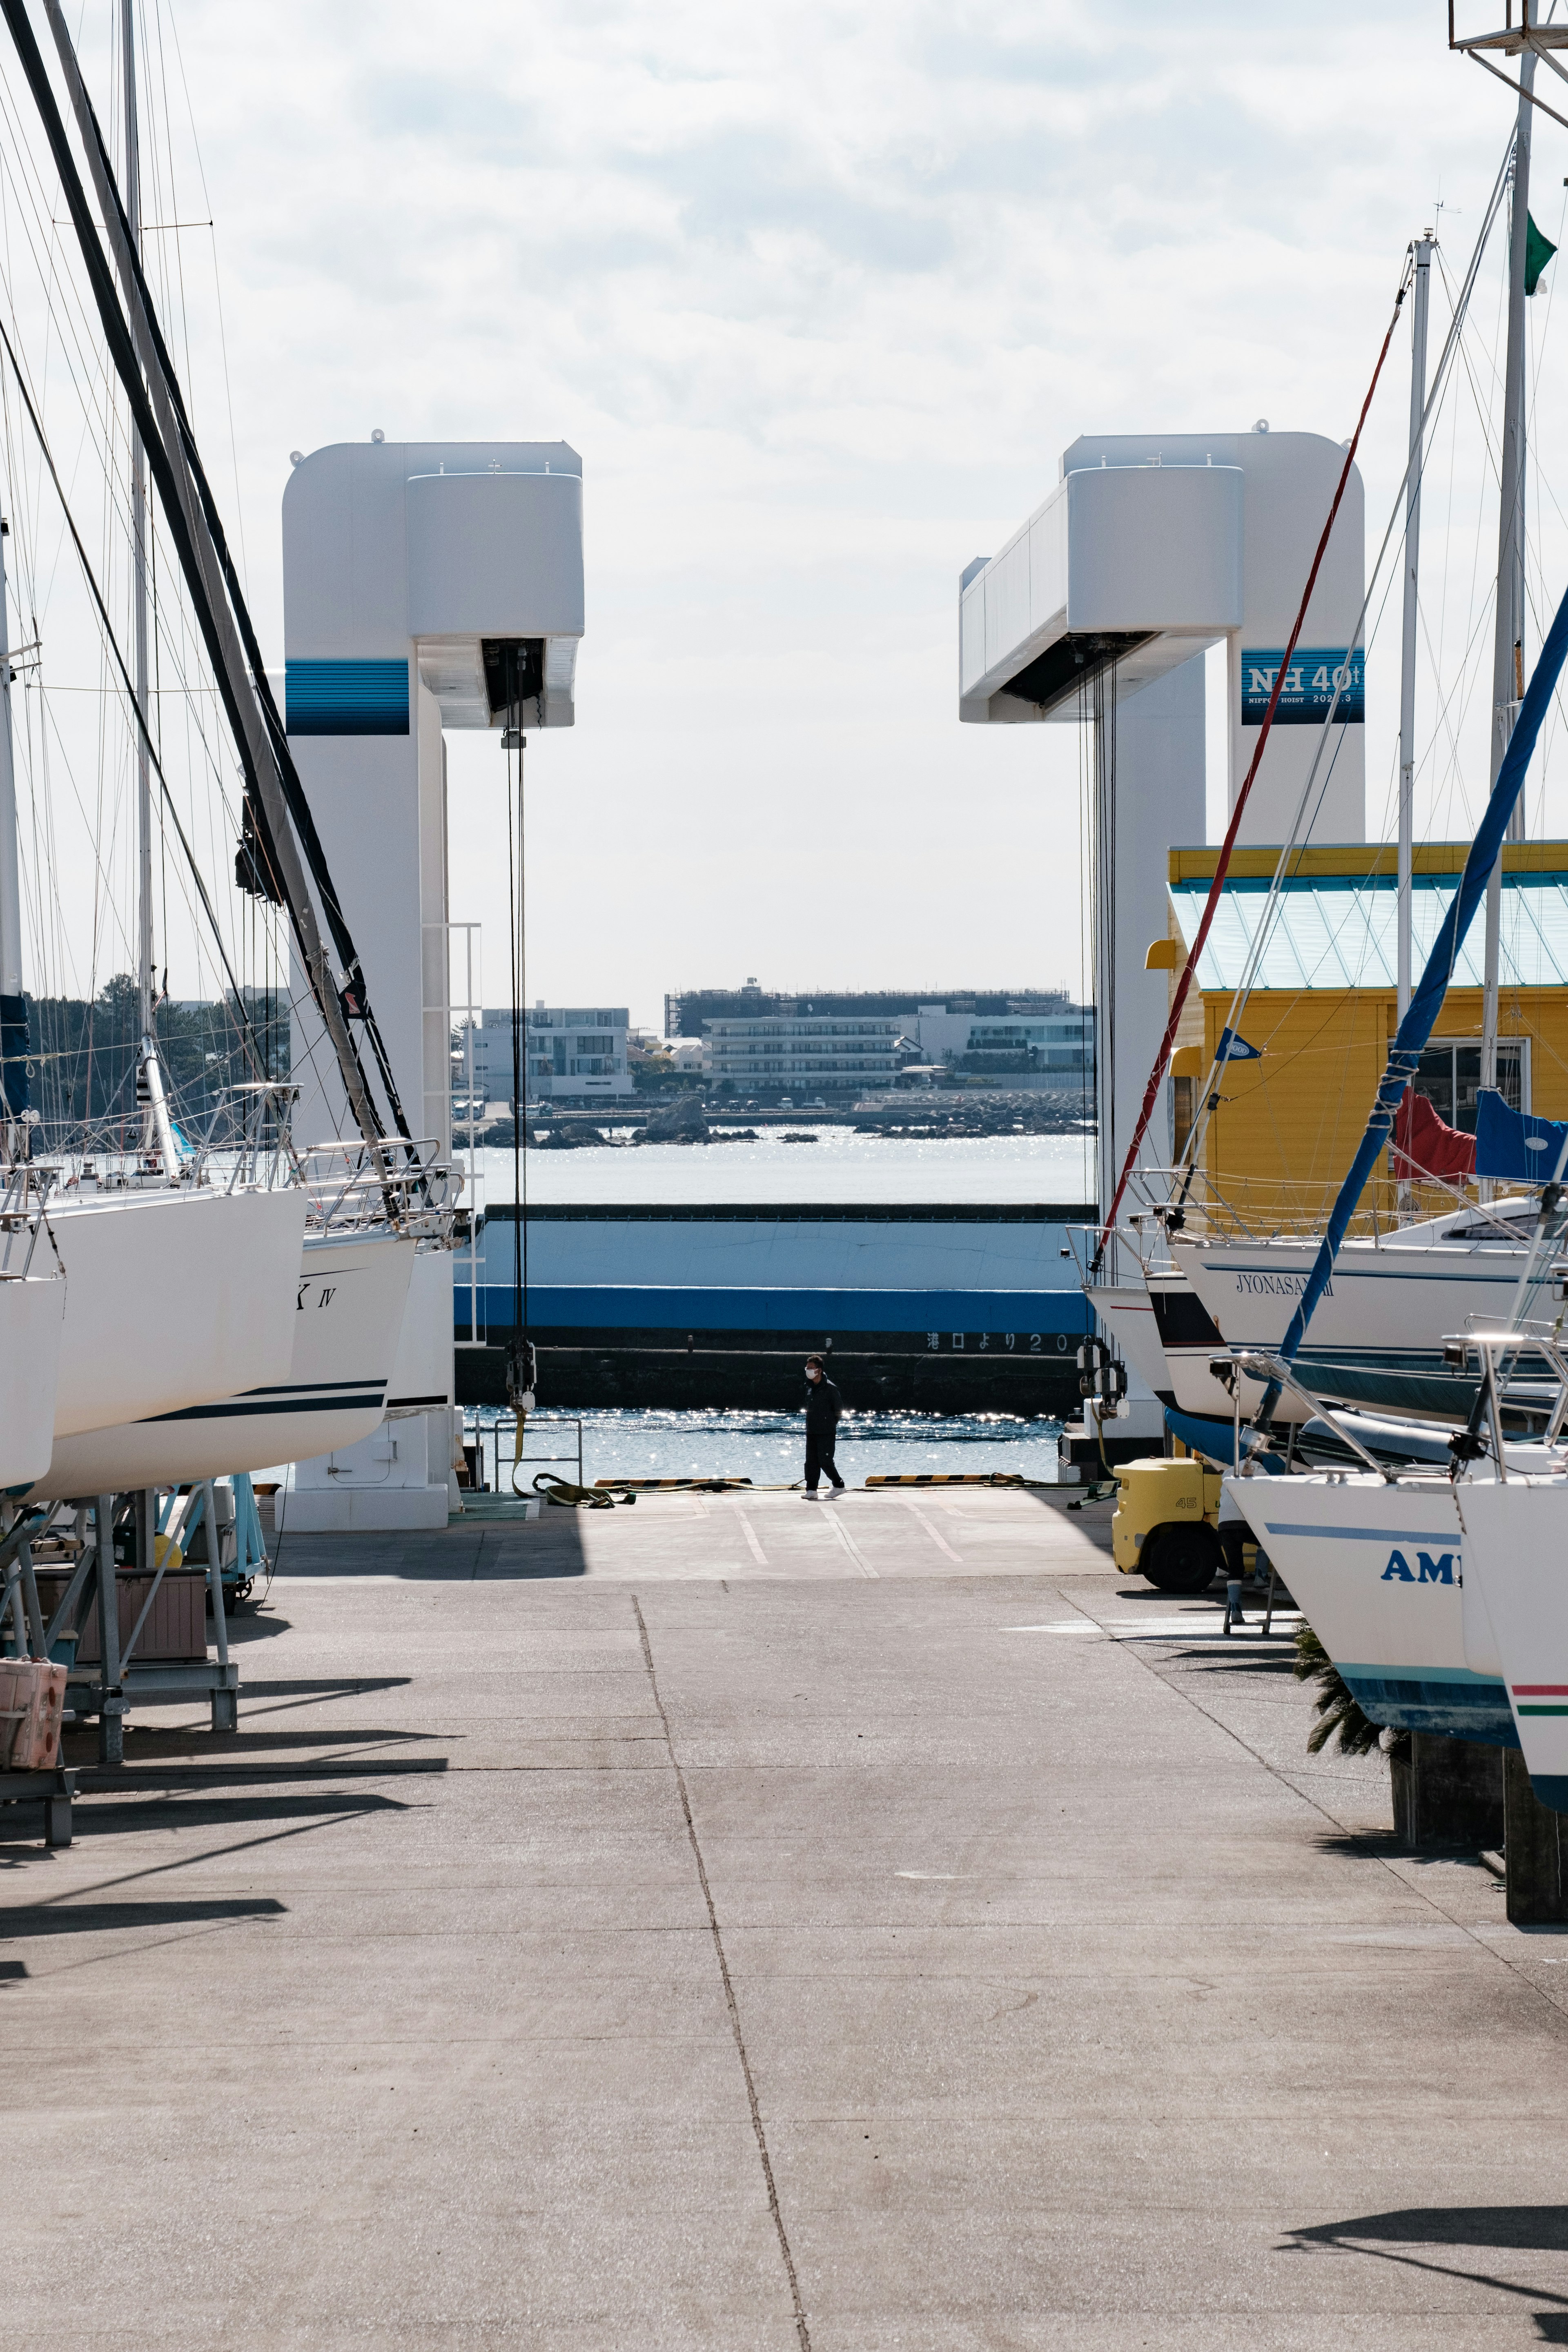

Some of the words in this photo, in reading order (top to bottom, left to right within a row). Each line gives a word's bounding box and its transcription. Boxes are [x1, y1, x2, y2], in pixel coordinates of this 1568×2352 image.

[1249, 668, 1304, 692] NH
[318, 1288, 336, 1307] IV
[1176, 1497, 1197, 1509] 45
[1381, 1550, 1461, 1585] AM
